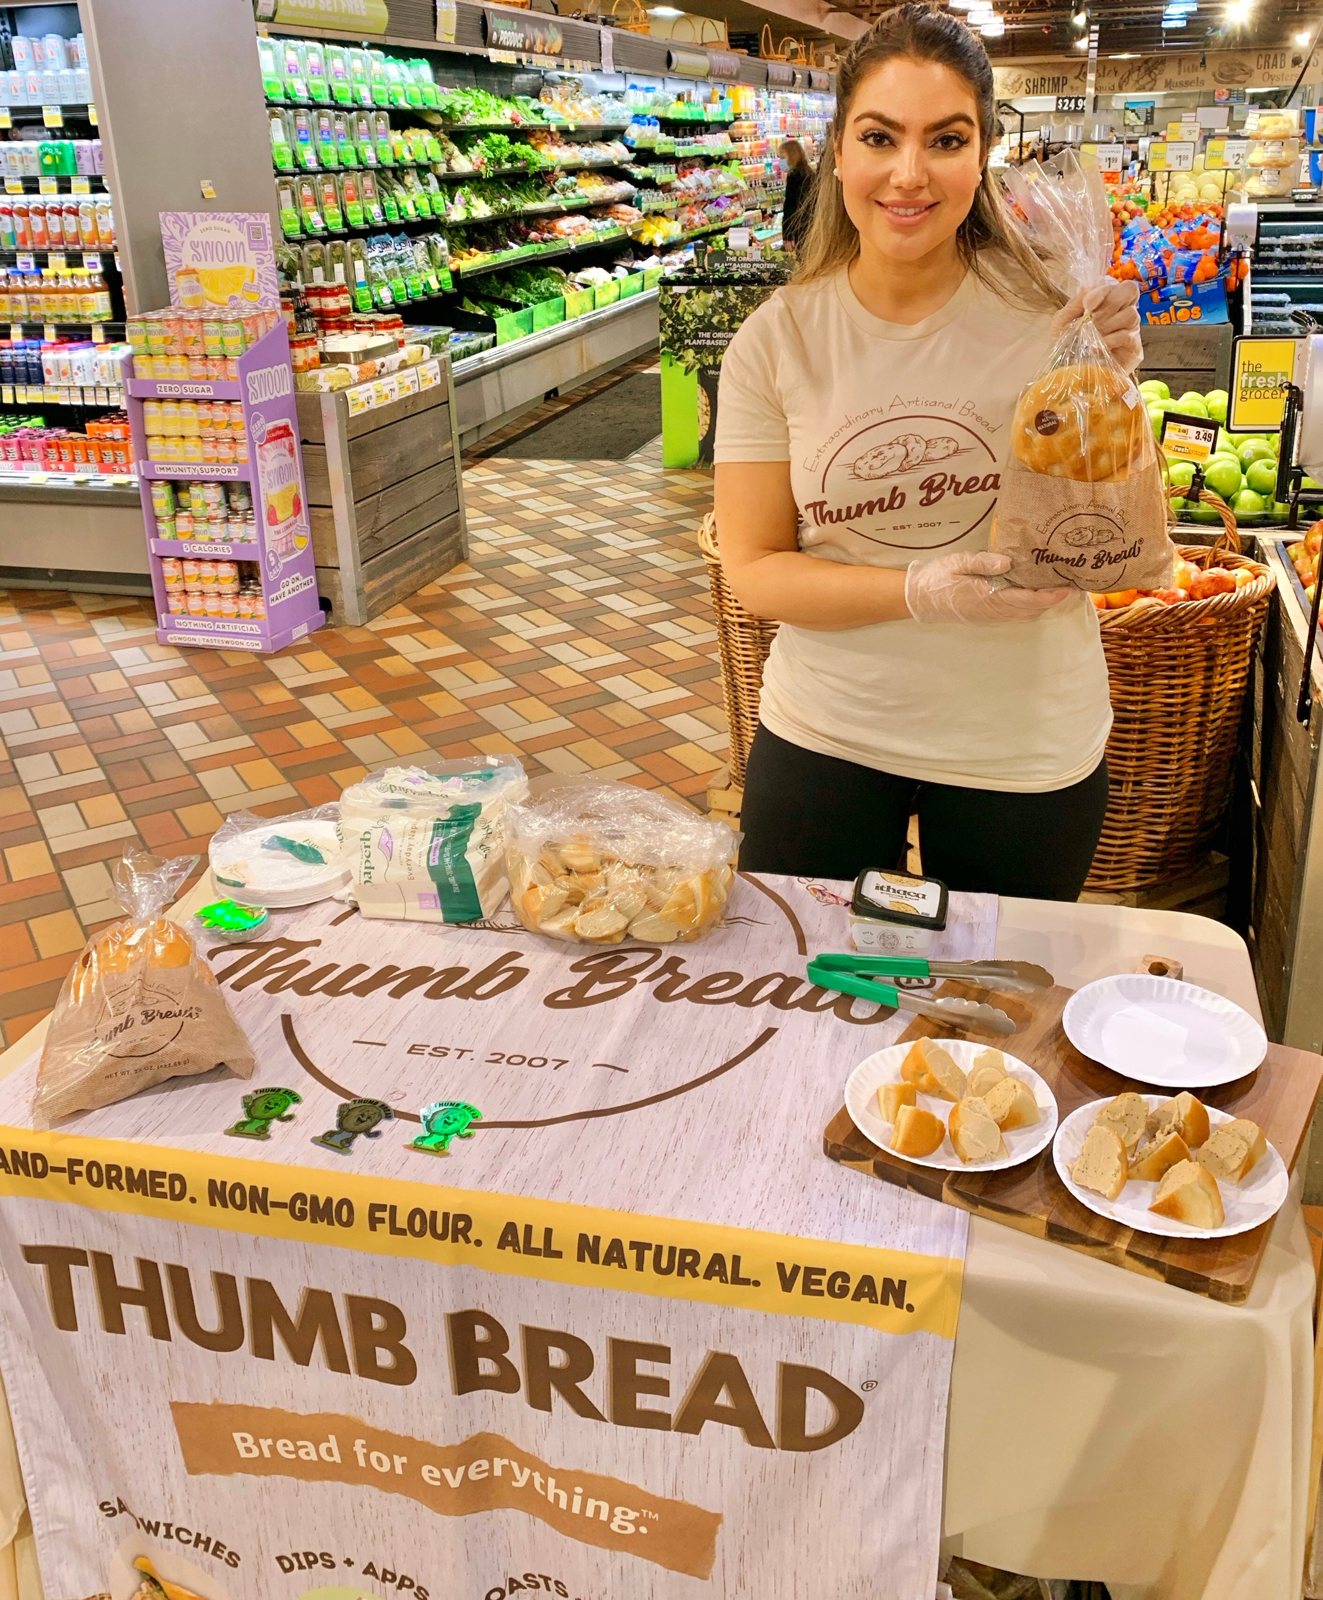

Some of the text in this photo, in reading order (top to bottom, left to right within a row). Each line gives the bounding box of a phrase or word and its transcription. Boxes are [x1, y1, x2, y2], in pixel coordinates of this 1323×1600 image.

[1256, 52, 1286, 70] CRAB
[1025, 76, 1068, 95] SHRIMP
[1164, 77, 1206, 89] Mussels
[1146, 304, 1202, 325] halos
[1242, 360, 1262, 373] the
[1241, 372, 1288, 388] fresh
[158, 385, 212, 394] ZERO SUGAR
[1240, 389, 1285, 402] grocer
[802, 394, 1004, 473] Extraordinary Artisanal Bread
[1195, 430, 1213, 443] 3.49
[156, 466, 198, 474] IMMUNITY
[804, 486, 906, 528] Thumb
[917, 521, 942, 530] 2007
[192, 545, 231, 553] CALORIES
[1031, 547, 1086, 568] Thumb
[268, 552, 276, 565] 5
[270, 577, 314, 604] HAVE ANOTHER
[281, 580, 290, 589] GO
[176, 621, 260, 633] NOTHING ARTIFICIAL
[404, 842, 415, 881] Everyday
[874, 882, 928, 900] ithaca
[207, 938, 529, 1001] Thumb
[406, 1044, 569, 1072] EST. 2007
[353, 1099, 379, 1109] THUMB
[208, 1178, 354, 1229] NON-GMO
[368, 1203, 483, 1248] FLOUR.
[497, 1221, 563, 1259] ALL
[576, 1232, 761, 1288] NATURAL.
[776, 1262, 915, 1314] VEGAN.
[19, 1244, 418, 1387] THUMB
[232, 1431, 342, 1465] Bread
[353, 1438, 408, 1476] for
[99, 1496, 241, 1569] SAWICHES
[275, 1551, 337, 1575] DIPS
[362, 1561, 430, 1600] APPS
